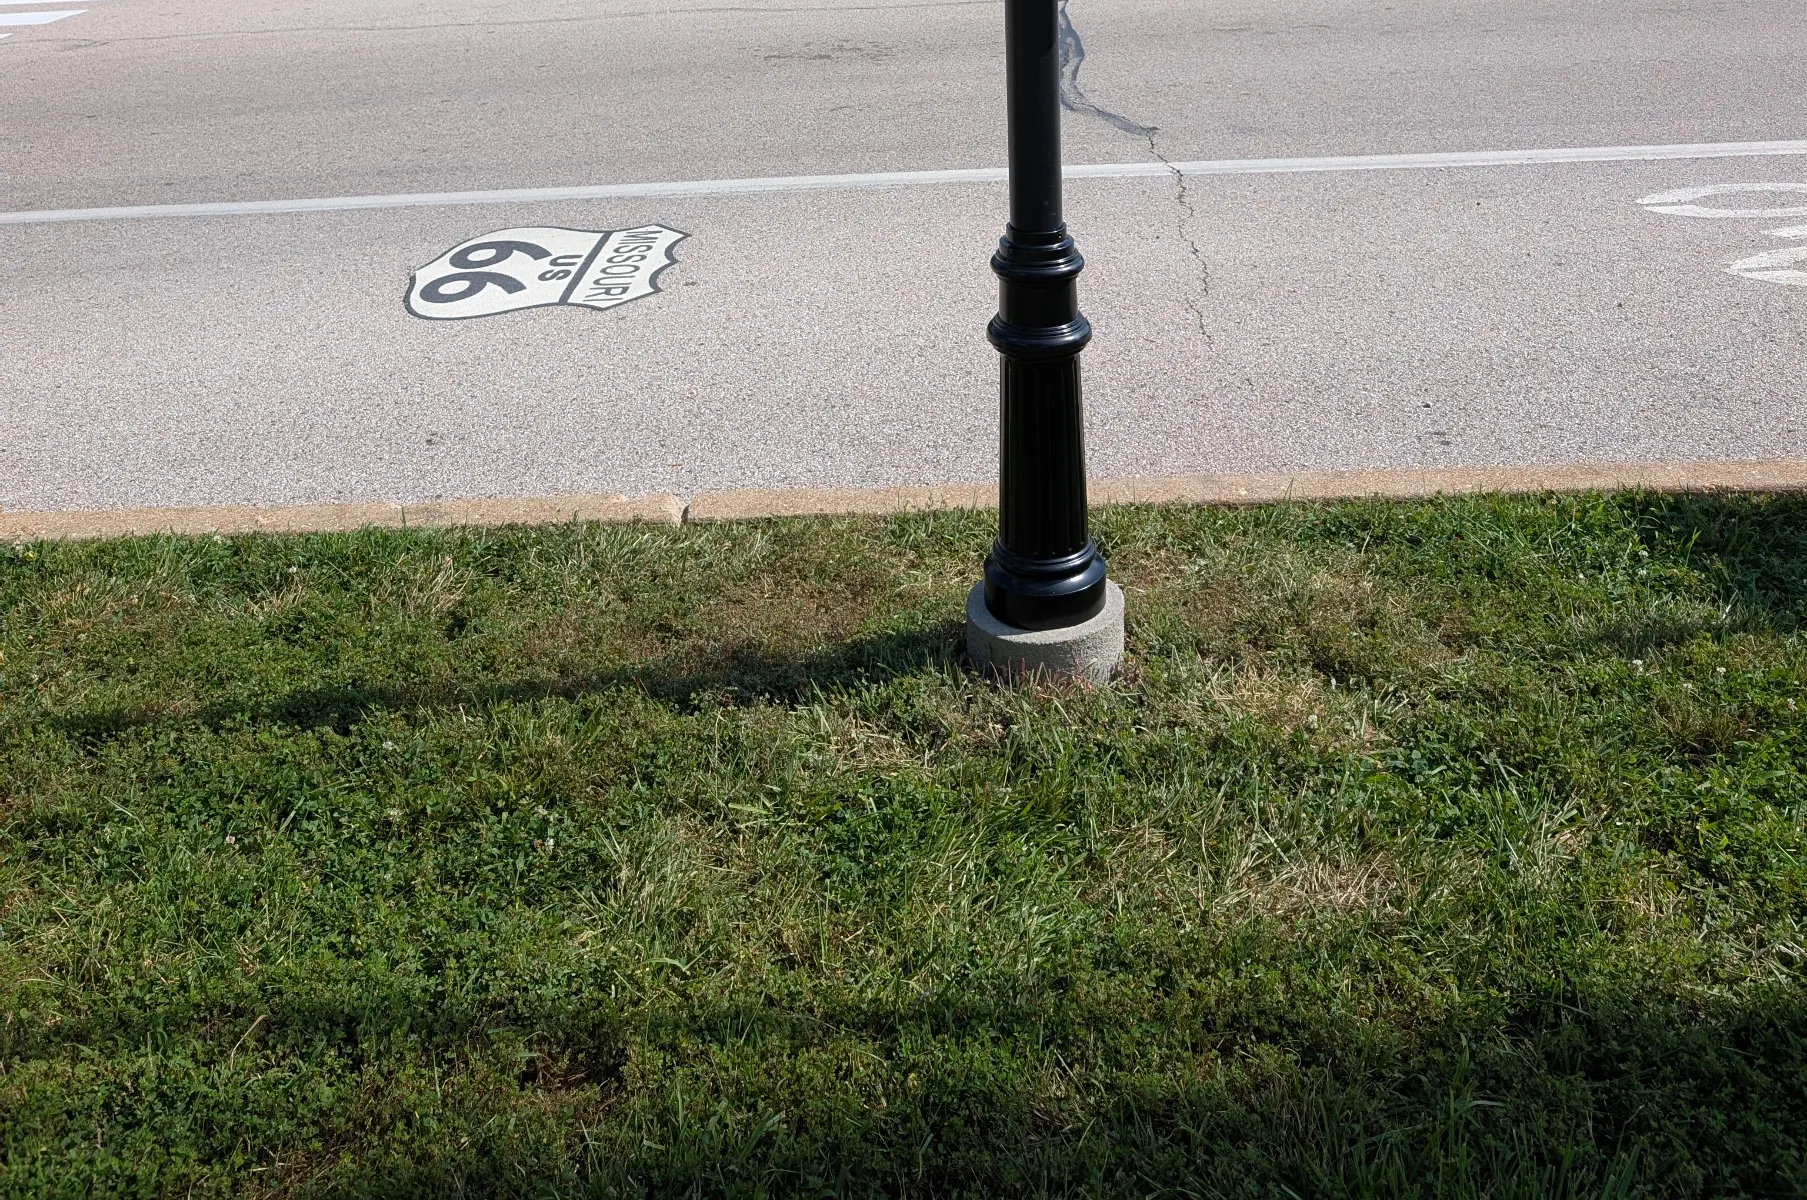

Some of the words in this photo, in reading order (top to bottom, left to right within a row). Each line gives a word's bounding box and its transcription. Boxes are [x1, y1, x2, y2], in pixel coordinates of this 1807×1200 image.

[419, 240, 553, 304] 66
[537, 254, 584, 282] US
[583, 230, 663, 302] MISSOURI
